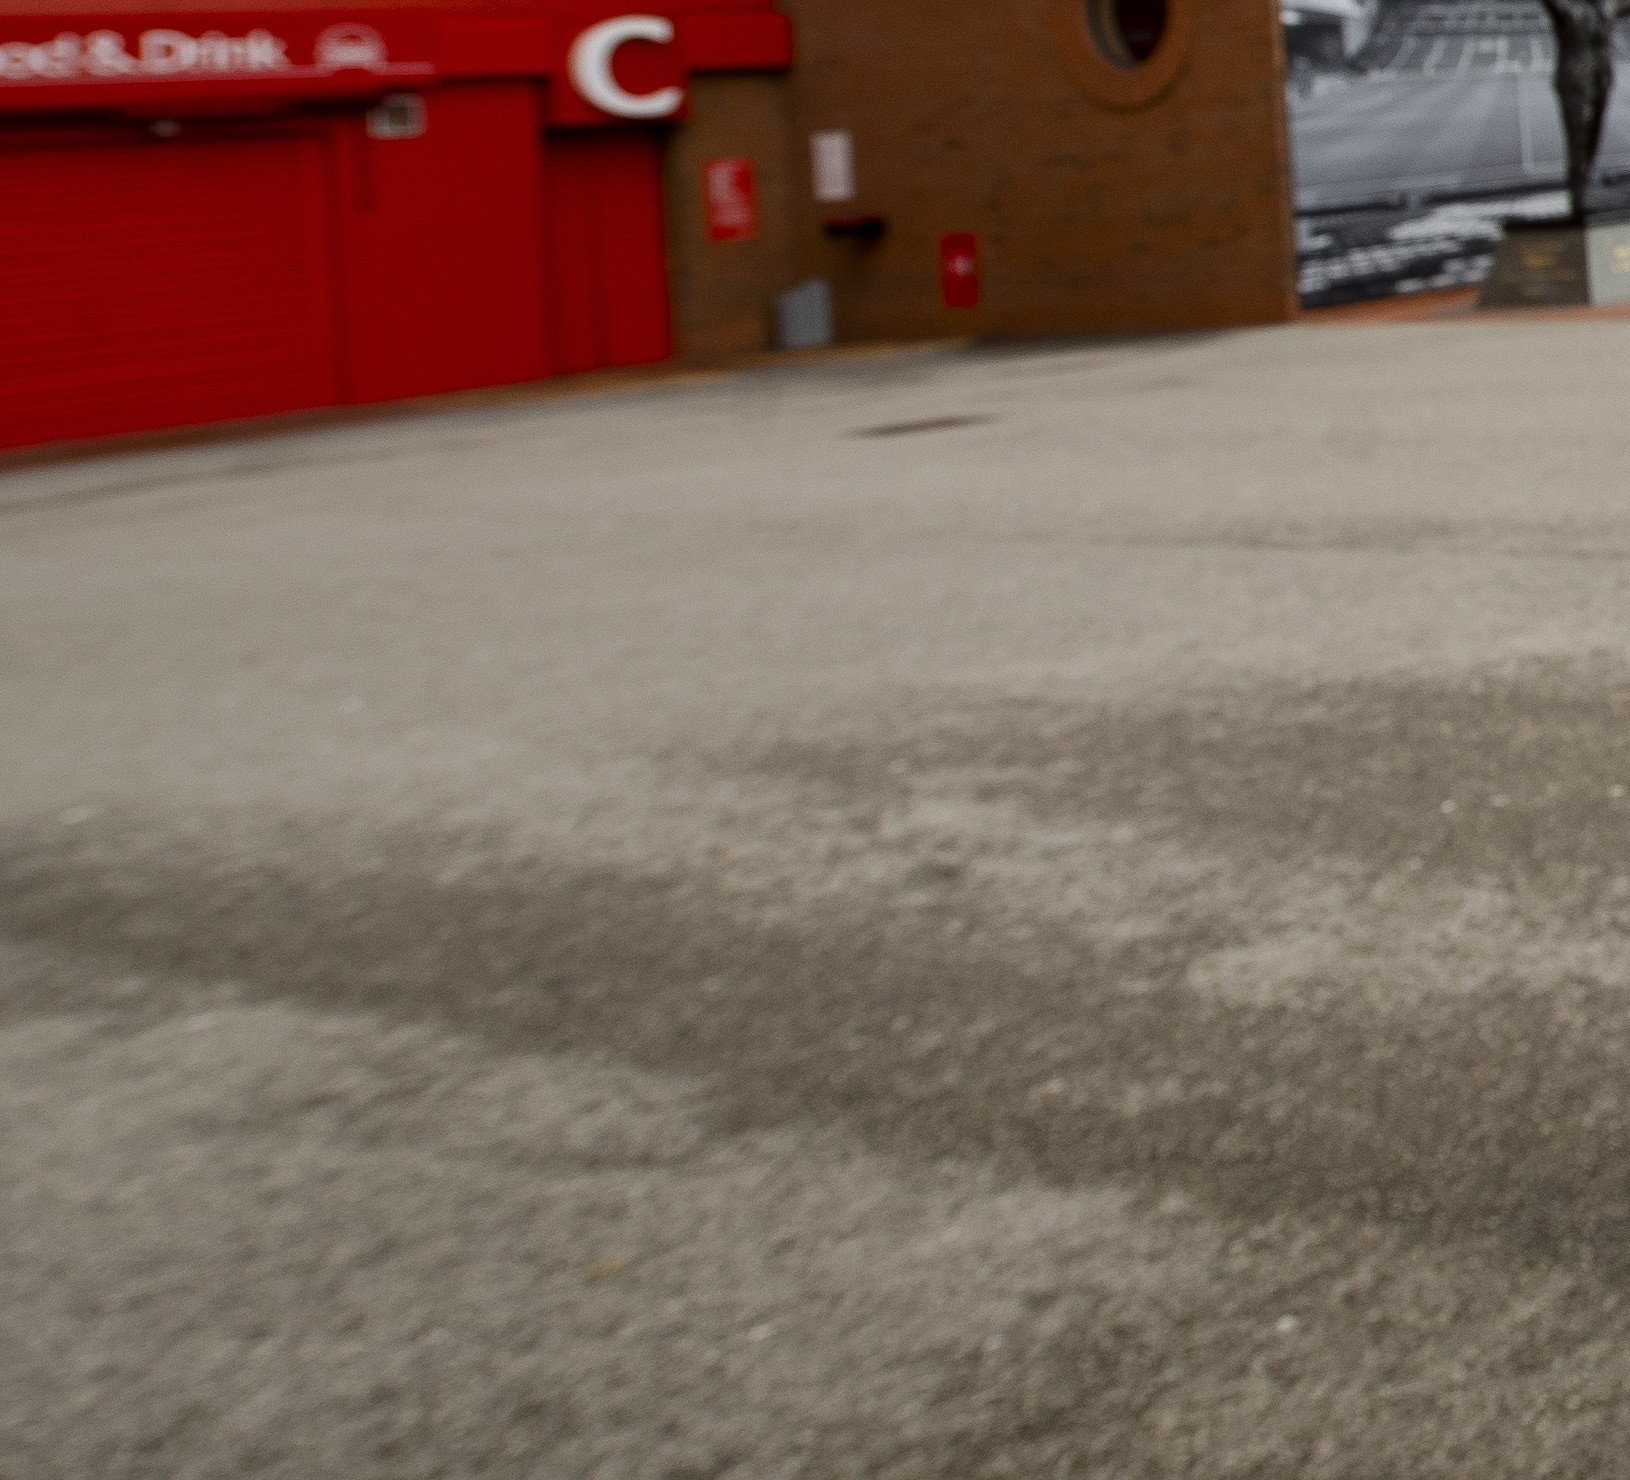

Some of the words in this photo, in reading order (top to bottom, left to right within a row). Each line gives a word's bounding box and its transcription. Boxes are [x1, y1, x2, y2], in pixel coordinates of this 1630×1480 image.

[84, 30, 139, 76] &
[139, 28, 291, 76] Drink
[567, 14, 684, 117] C
